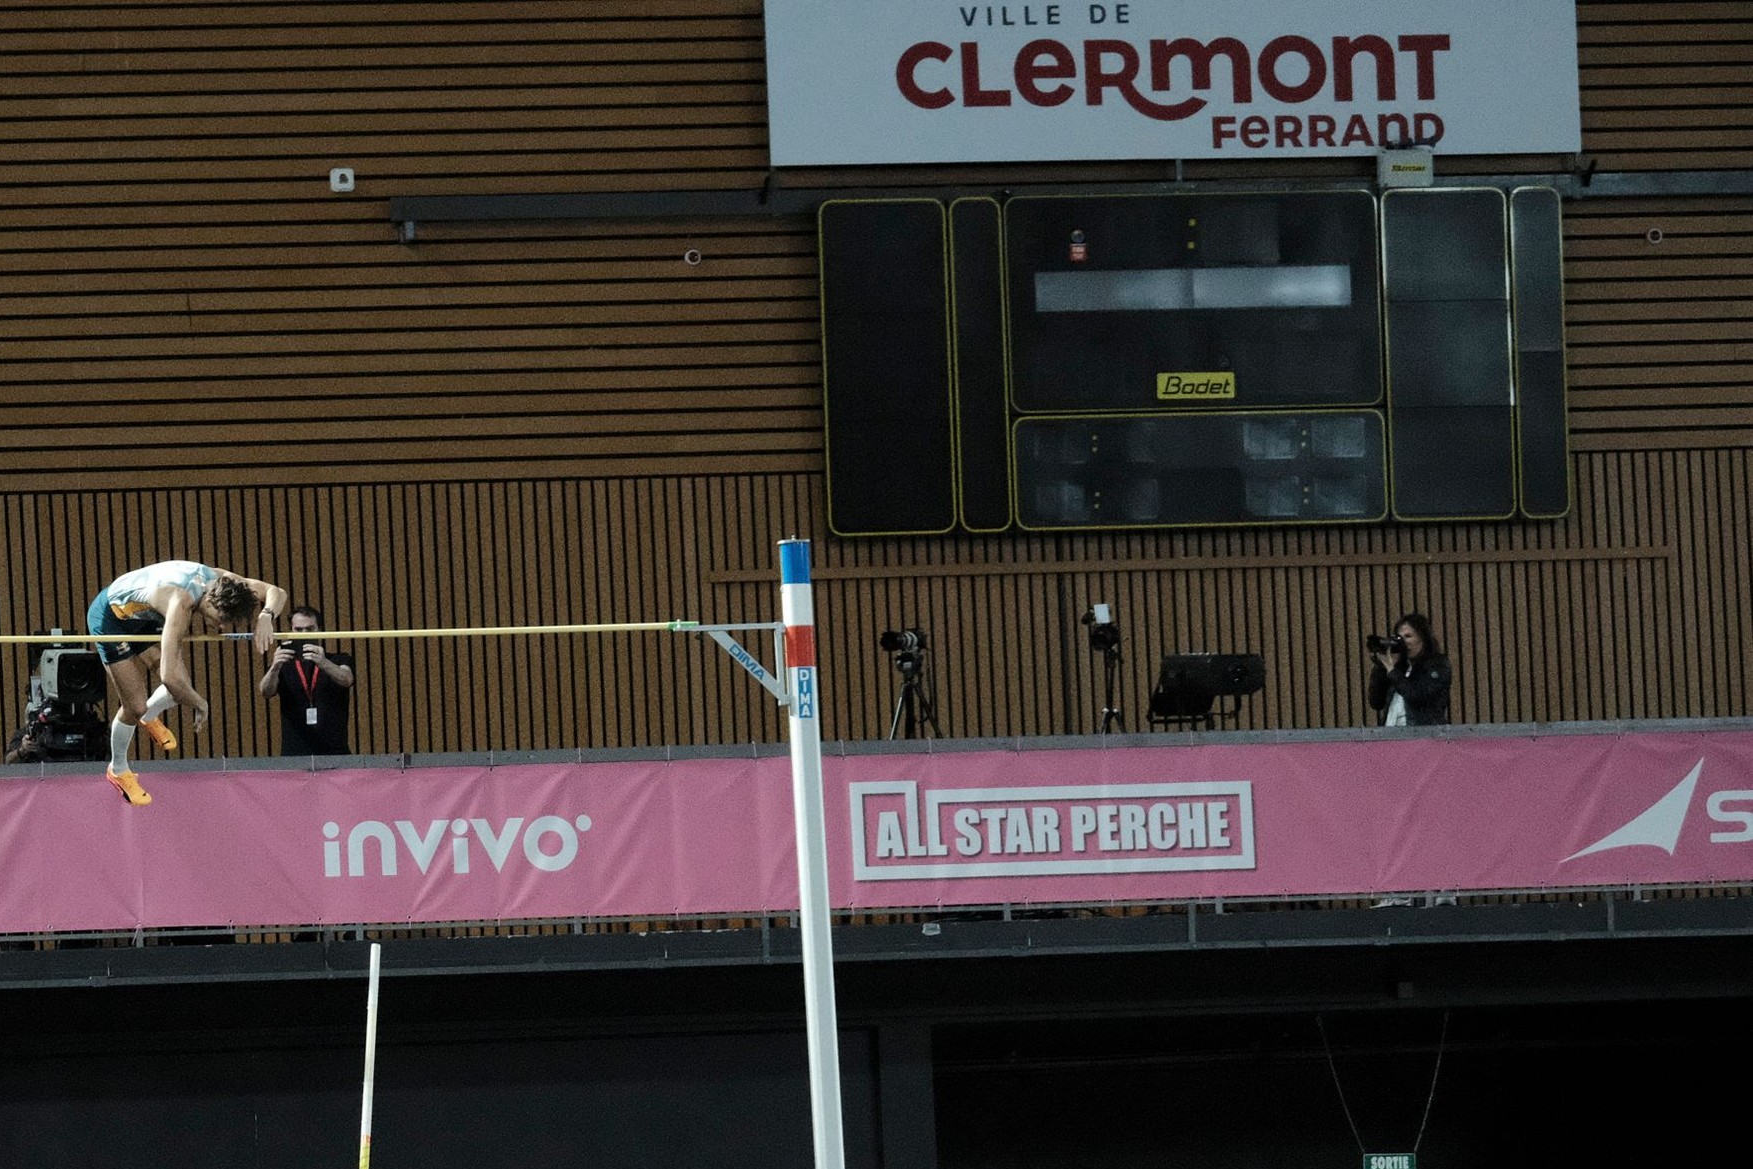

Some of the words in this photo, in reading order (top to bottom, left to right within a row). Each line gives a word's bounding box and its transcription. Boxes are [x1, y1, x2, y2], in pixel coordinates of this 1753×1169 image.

[960, 4, 1062, 27] VILLE
[1090, 2, 1130, 25] DE
[1162, 376, 1231, 395] Bodet
[729, 643, 765, 680] DIMA
[799, 669, 812, 717] DIMA
[876, 787, 948, 858] ALL
[955, 806, 1061, 857] STAR
[1071, 801, 1231, 853] PERCHE
